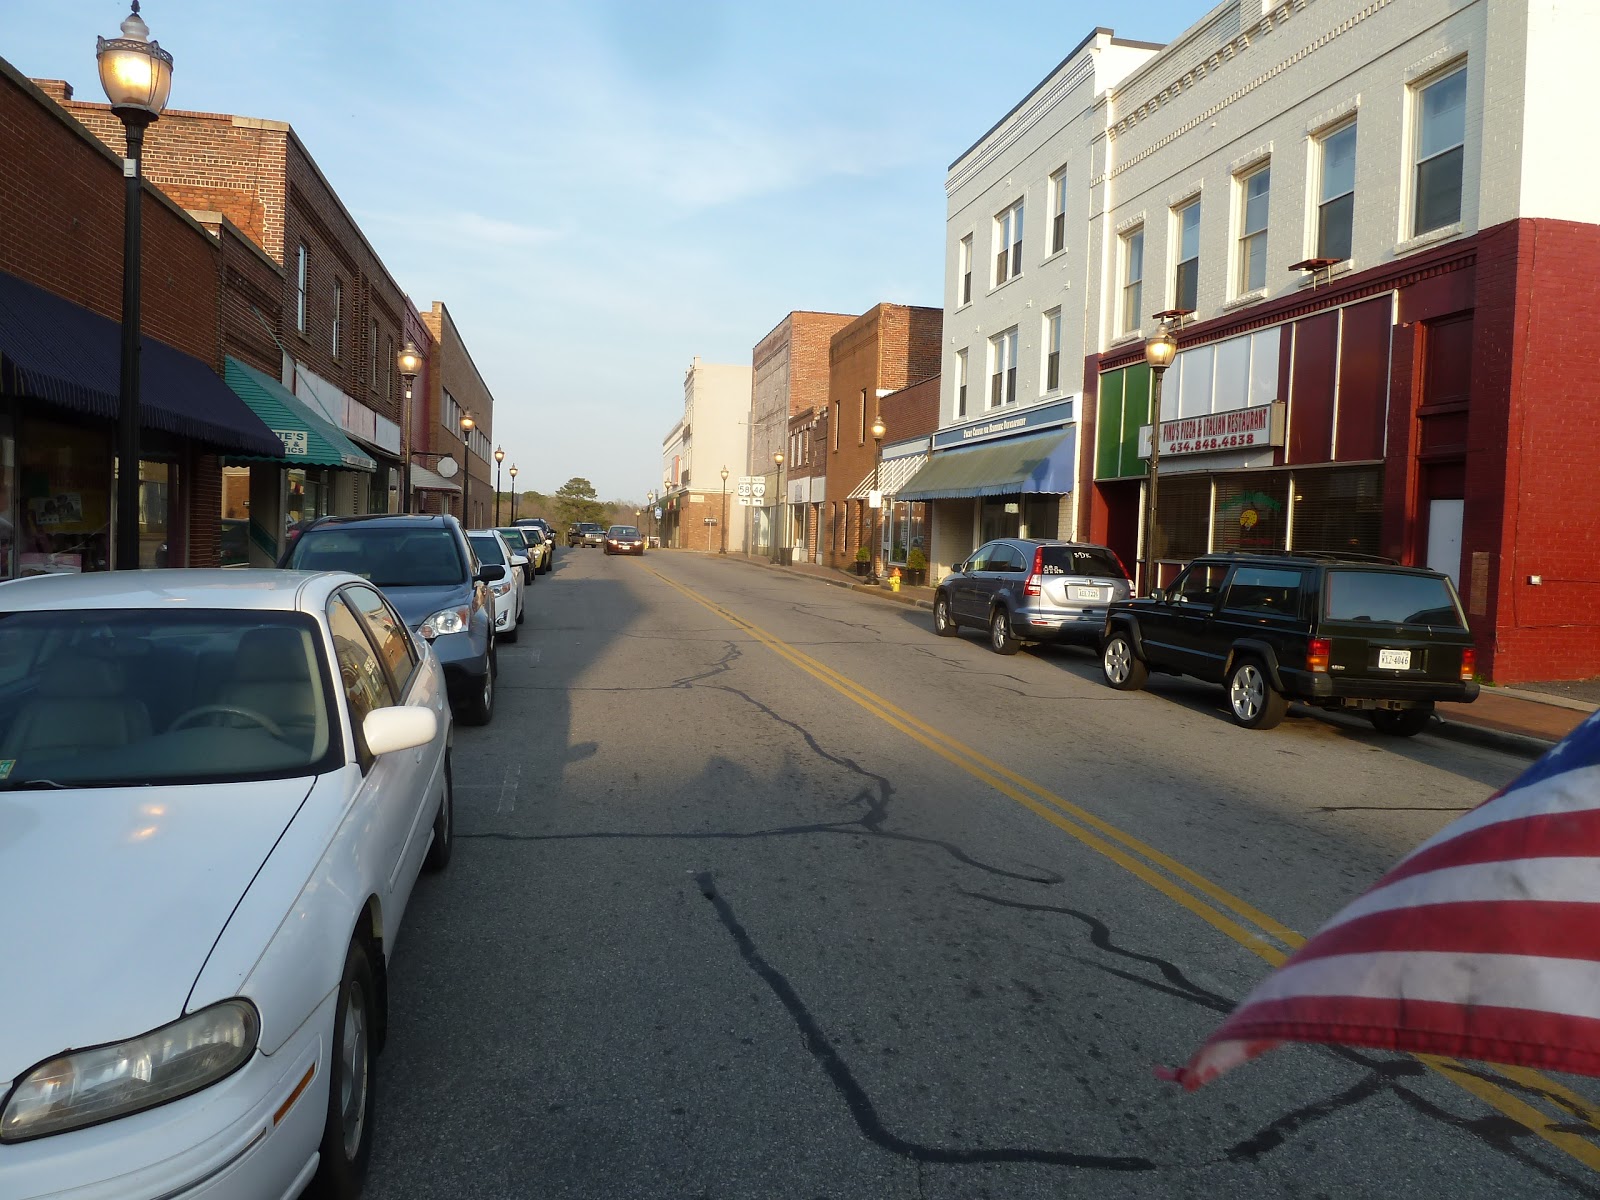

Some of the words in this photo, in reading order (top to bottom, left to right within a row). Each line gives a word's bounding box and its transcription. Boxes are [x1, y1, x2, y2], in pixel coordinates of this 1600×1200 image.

[1181, 419, 1196, 440] PIZZA
[1197, 419, 1203, 438] &
[1203, 414, 1226, 437] ITALIAN
[1227, 408, 1267, 433] RESTAURANT
[275, 432, 304, 441] TE'S
[1170, 433, 1254, 453] 434.848.4838
[739, 485, 750, 494] 58
[754, 486, 764, 494] 46
